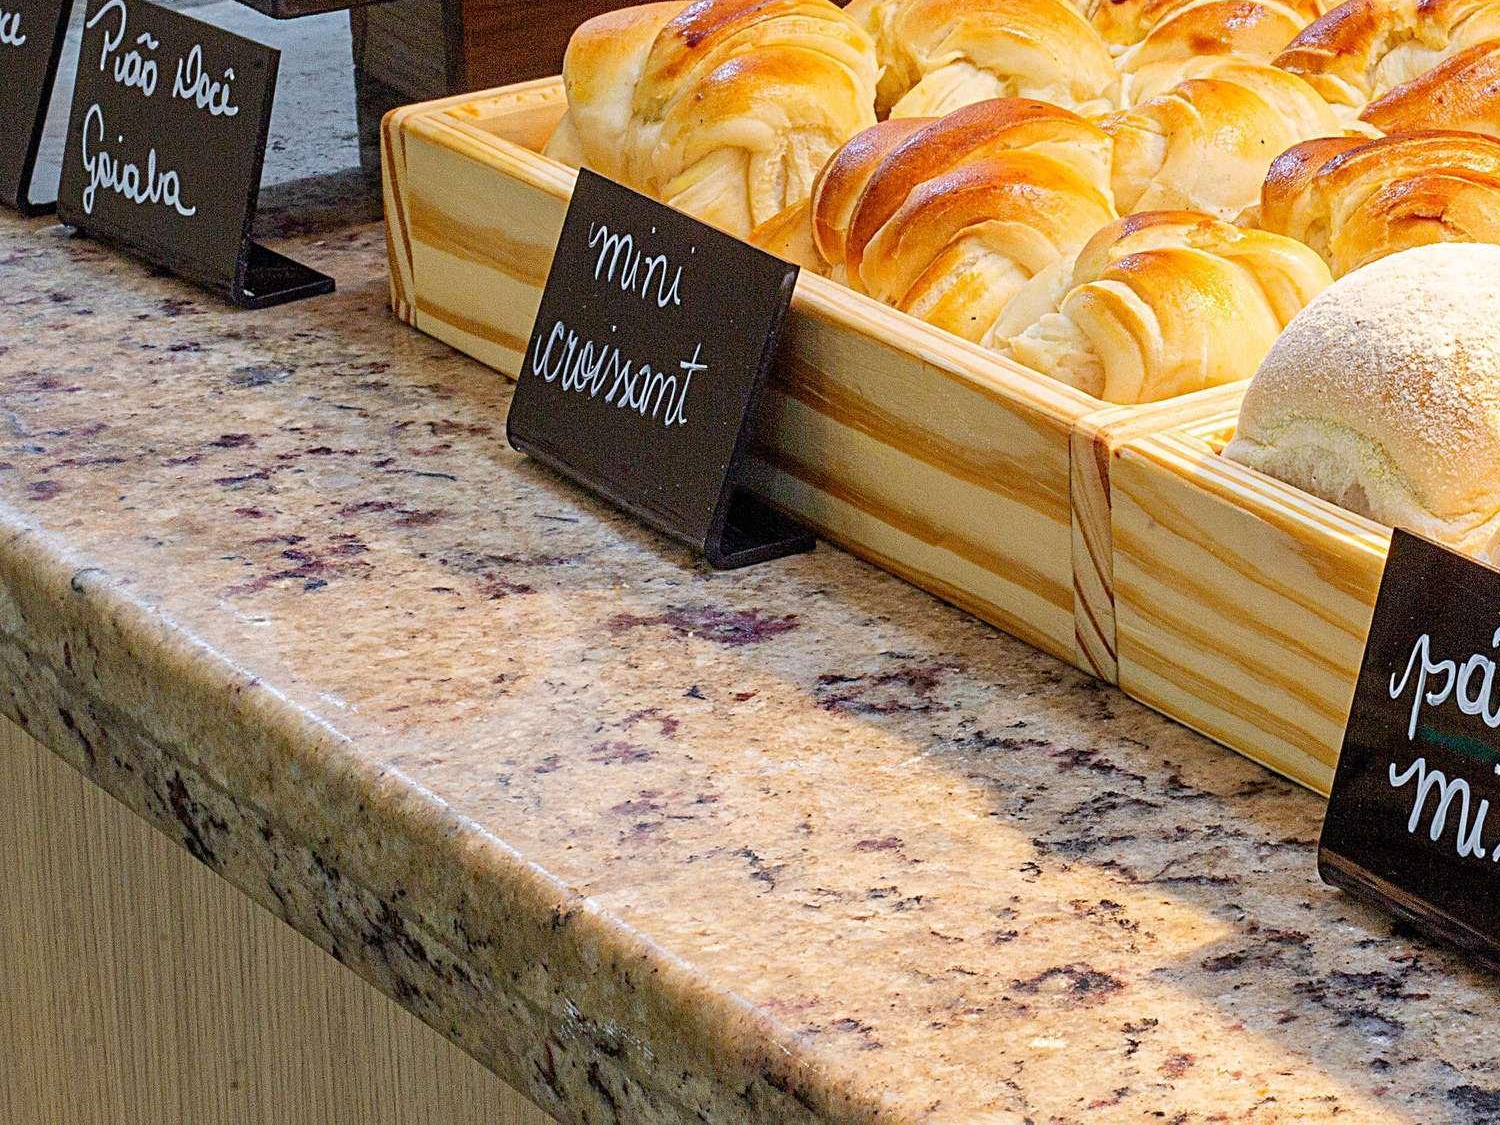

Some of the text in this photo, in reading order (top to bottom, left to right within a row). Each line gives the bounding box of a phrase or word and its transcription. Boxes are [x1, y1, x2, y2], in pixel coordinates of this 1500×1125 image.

[82, 103, 196, 216] Goiaba
[588, 221, 696, 308] mini
[533, 321, 708, 427] croissant
